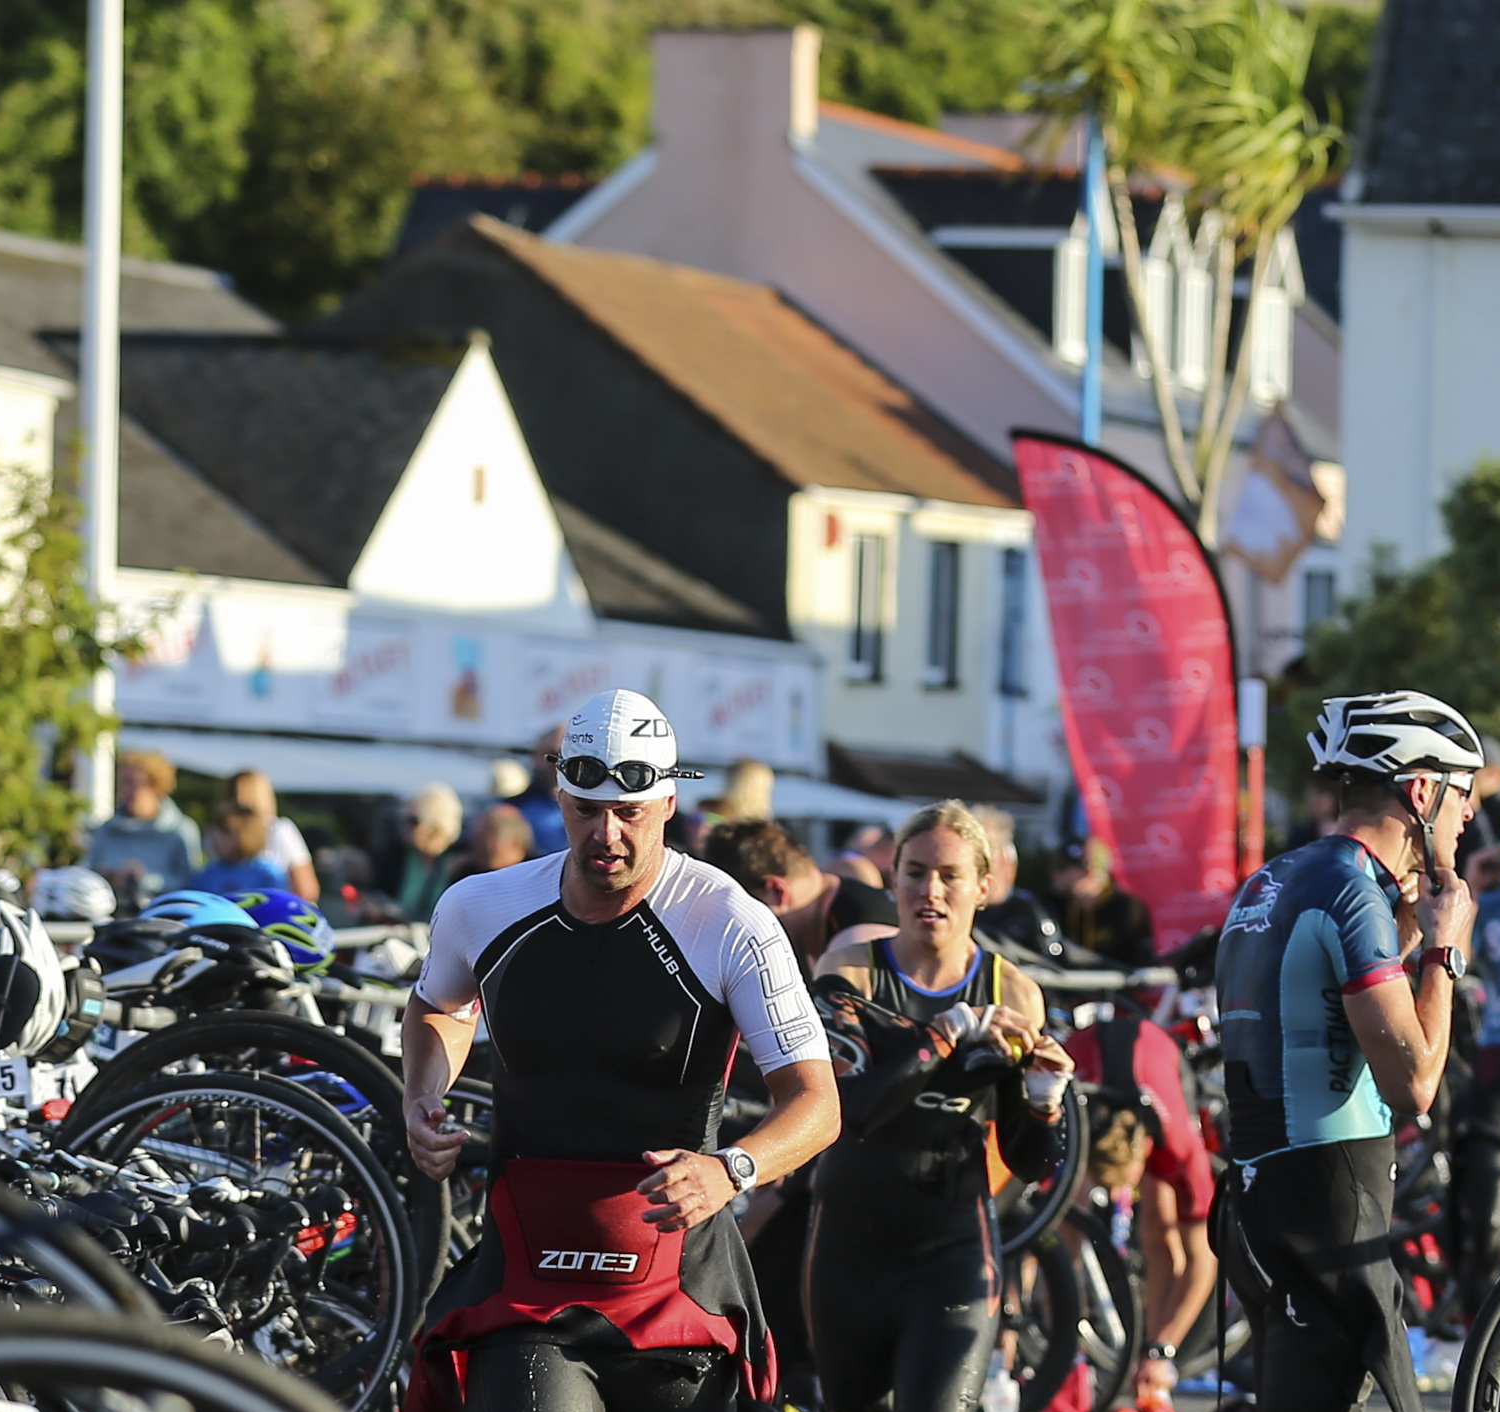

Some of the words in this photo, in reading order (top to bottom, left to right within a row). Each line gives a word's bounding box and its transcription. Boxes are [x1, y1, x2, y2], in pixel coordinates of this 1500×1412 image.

[629, 718, 669, 738] ZO
[642, 923, 681, 976] HUUB
[1321, 987, 1352, 1094] PACTIMO
[538, 1250, 639, 1273] ZONE3
